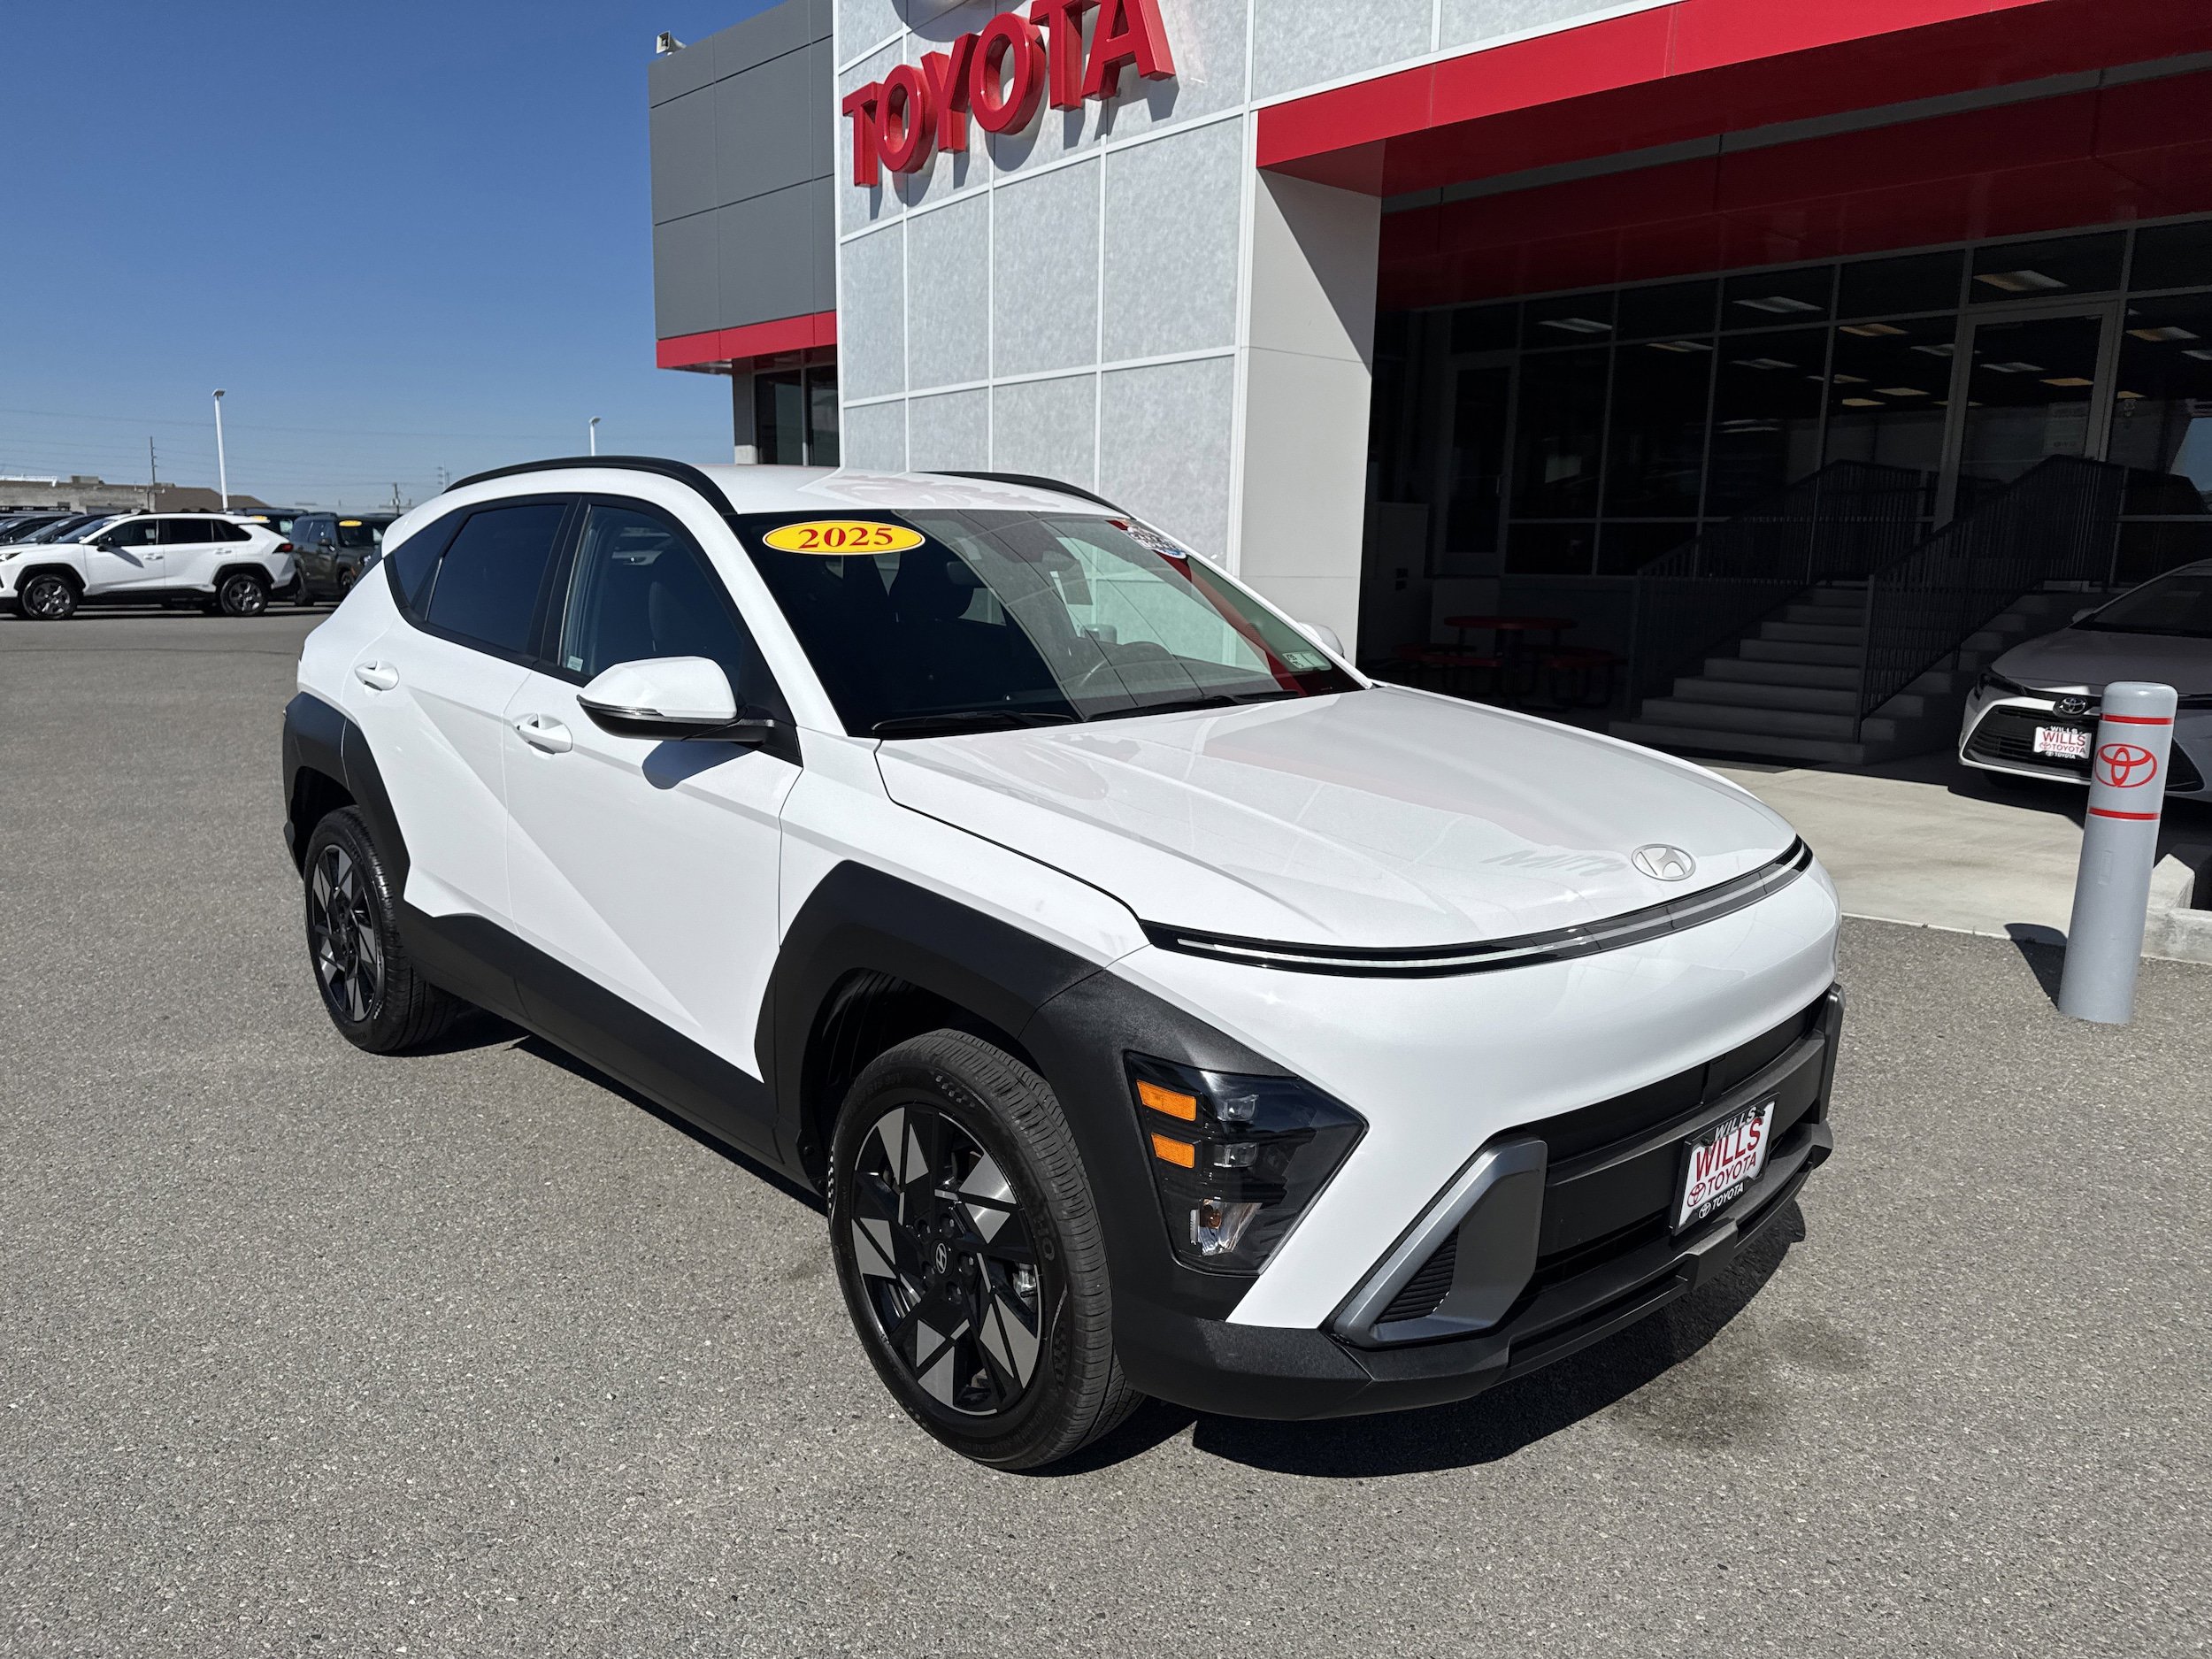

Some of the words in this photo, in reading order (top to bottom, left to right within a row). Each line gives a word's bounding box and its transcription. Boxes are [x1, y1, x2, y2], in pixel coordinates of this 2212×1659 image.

[842, 0, 1176, 188] TOYOTA
[798, 527, 894, 549] 2025
[2043, 731, 2086, 747] WILLS
[2050, 726, 2078, 734] WILLS
[2052, 744, 2085, 754] TOYOTA
[1715, 1106, 1757, 1141] WILLS
[1696, 1118, 1763, 1182] WILLS
[1708, 1152, 1756, 1194] TOYOTA
[1711, 1182, 1744, 1210] TOYOTA
